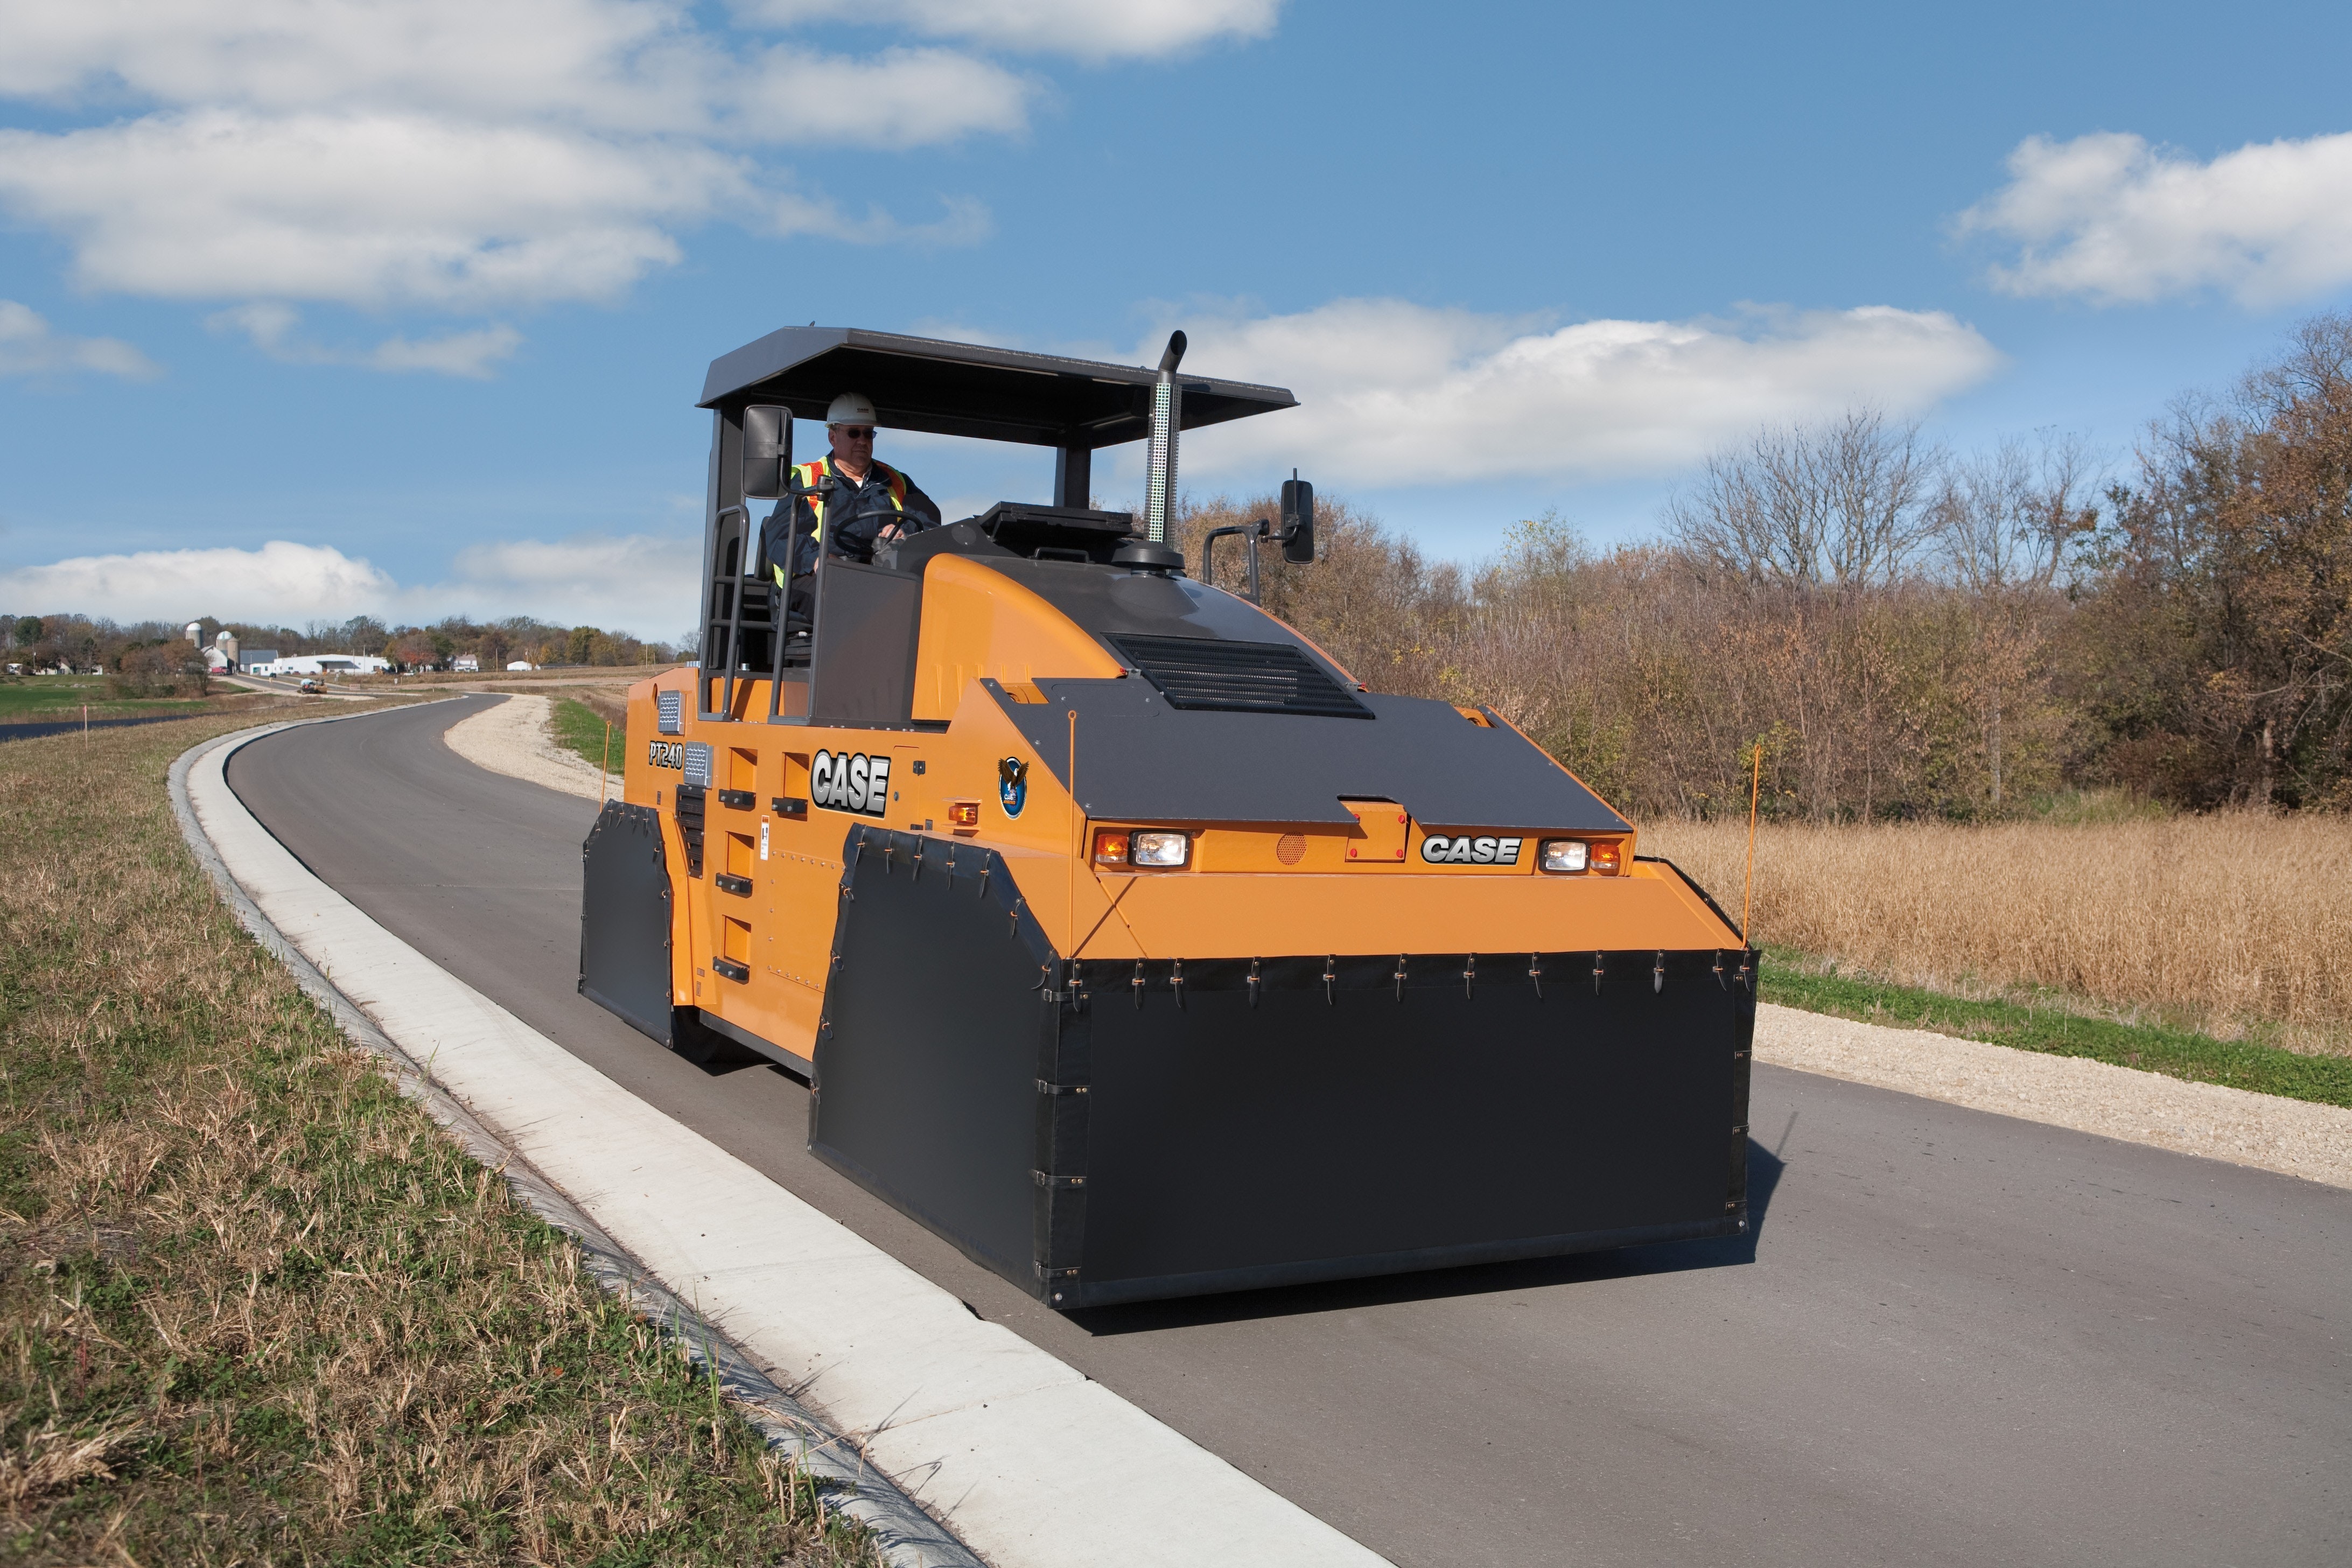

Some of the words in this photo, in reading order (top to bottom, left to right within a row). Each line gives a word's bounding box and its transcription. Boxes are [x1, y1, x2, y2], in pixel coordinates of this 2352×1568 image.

[649, 741, 683, 769] PT240
[811, 750, 891, 813] CASE
[1422, 836, 1522, 863] CASE
